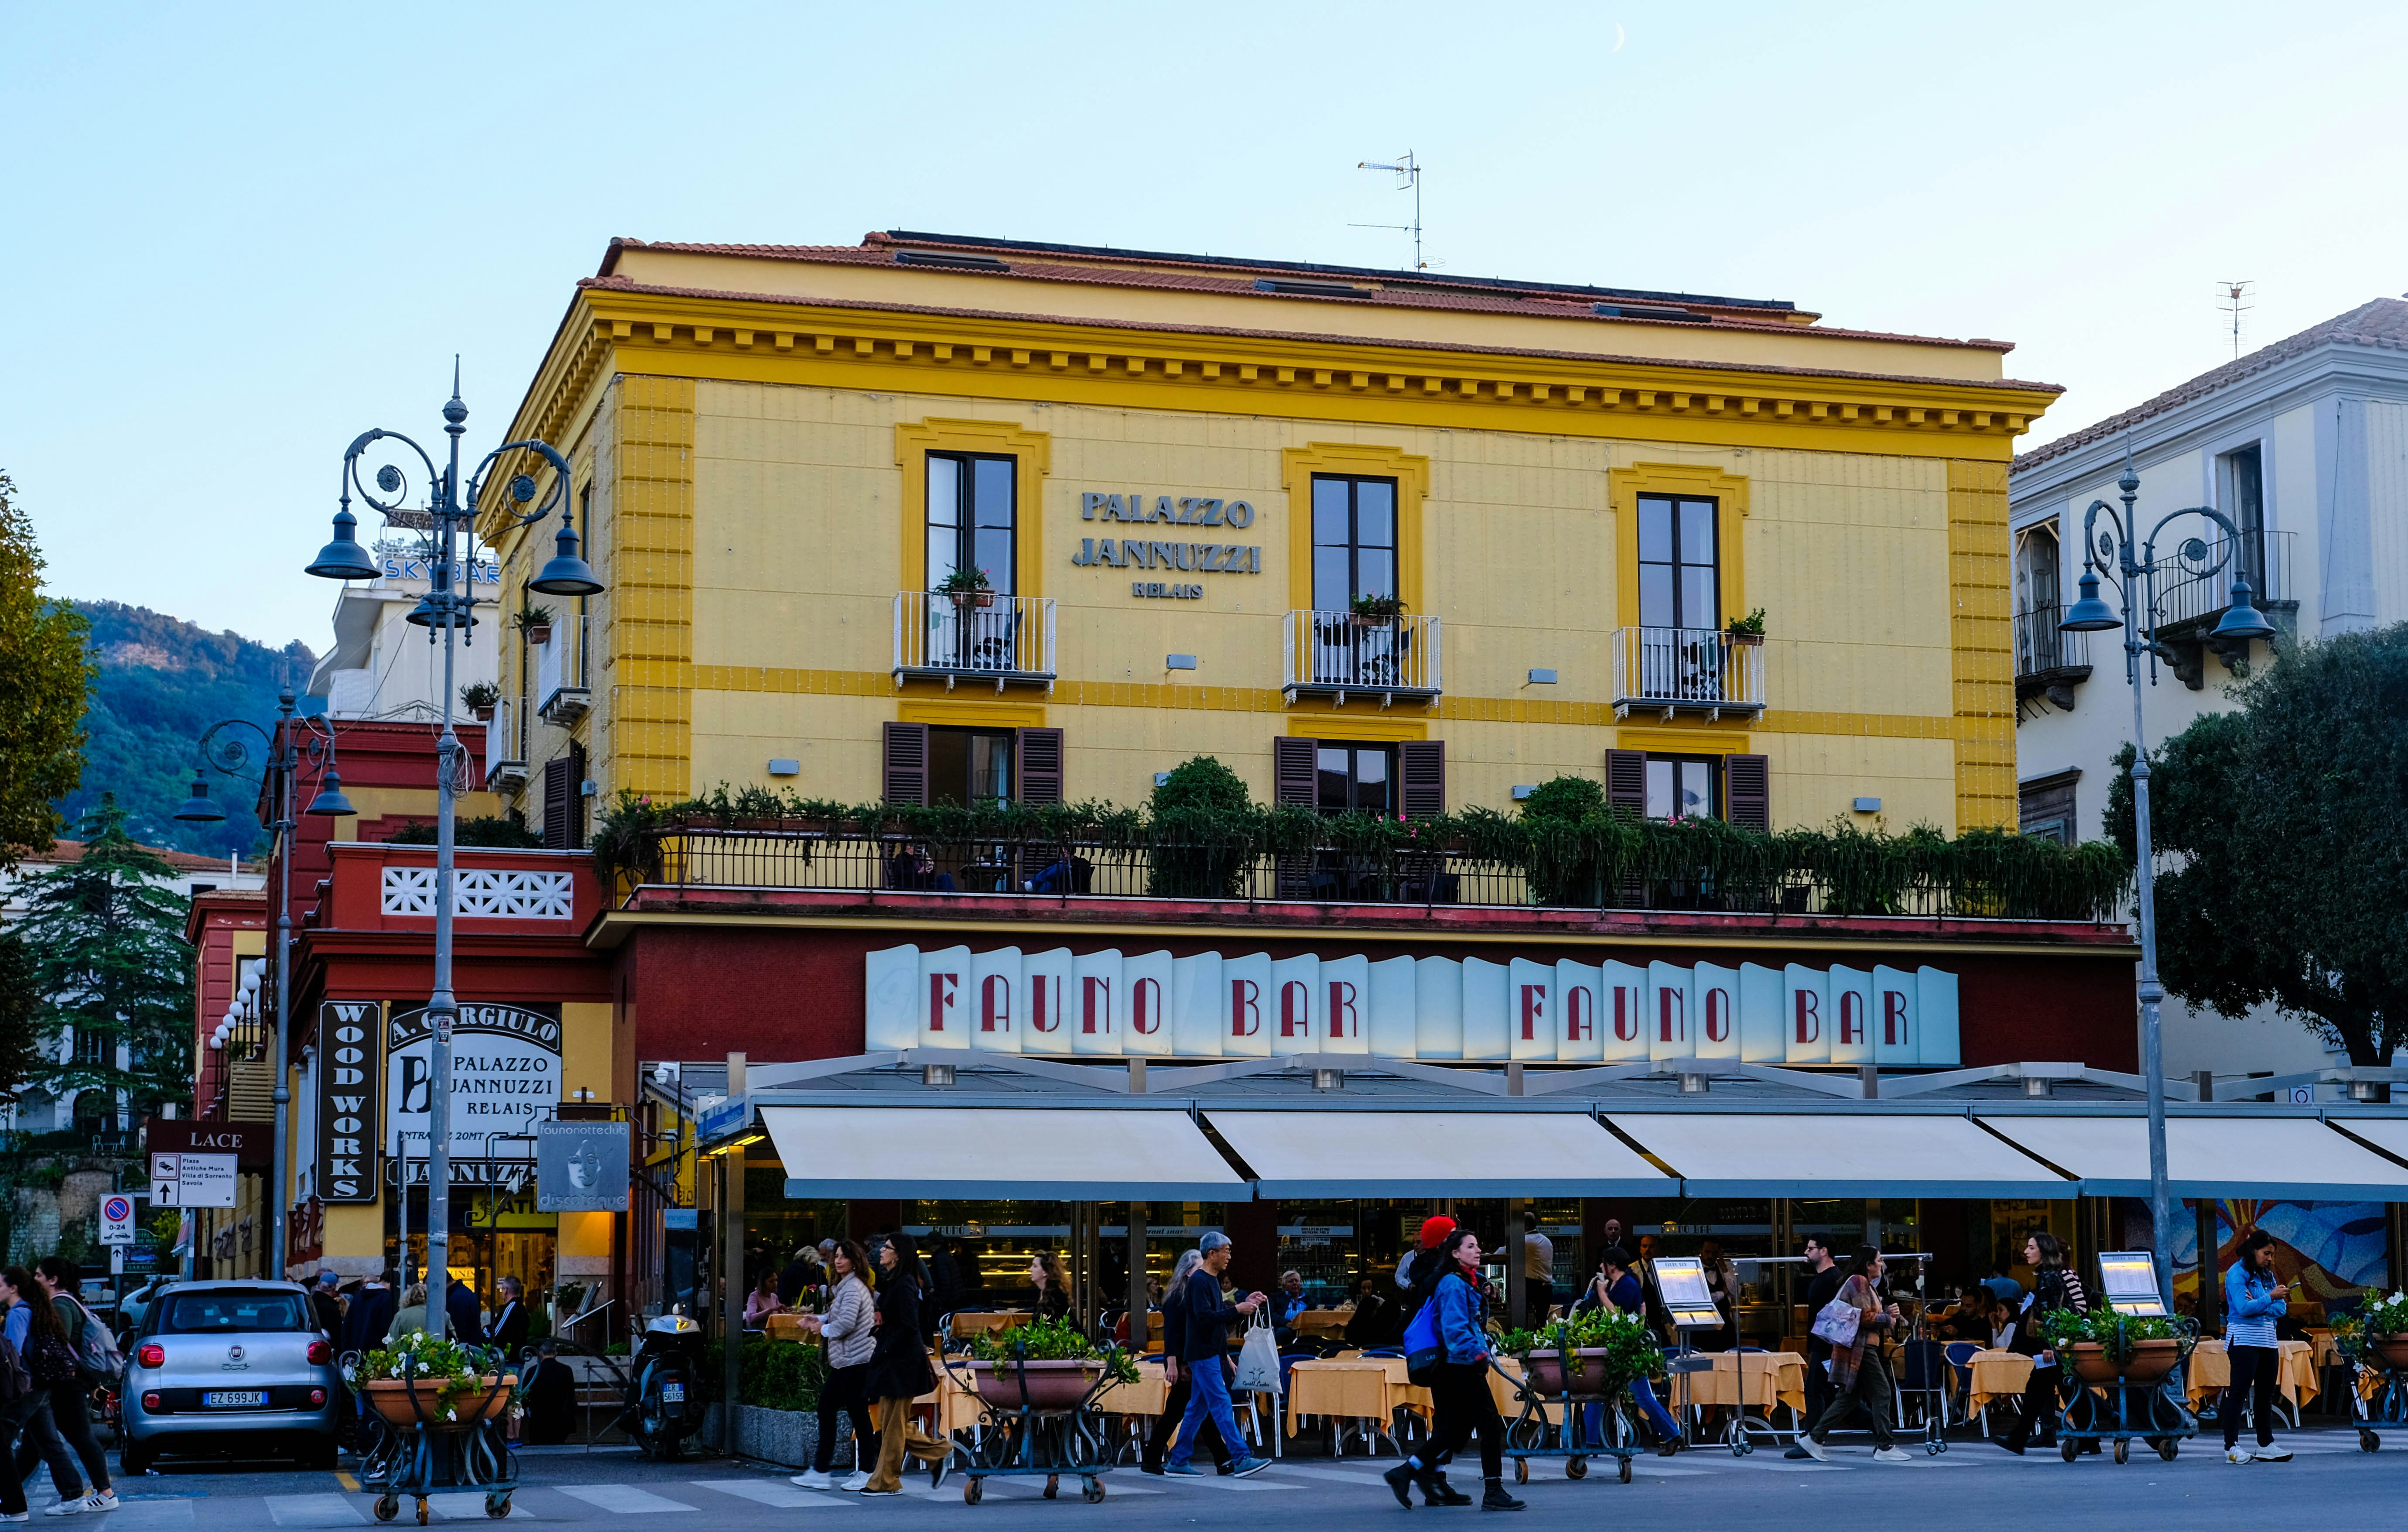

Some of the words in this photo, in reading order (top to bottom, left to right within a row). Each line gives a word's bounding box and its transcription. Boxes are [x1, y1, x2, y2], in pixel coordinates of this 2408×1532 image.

[1082, 492, 1255, 528] PALAZZO
[1071, 538, 1262, 574] JANNUZZI
[1132, 582, 1204, 598] RELAIS
[929, 973, 1161, 1035] FAUNO
[1231, 980, 1357, 1038] BAR
[1521, 985, 1729, 1043] FAUNO
[1795, 989, 1907, 1045] BAR
[393, 1022, 417, 1042] A.
[421, 1007, 557, 1041] GRGIULO
[332, 1005, 368, 1085] WOOD
[453, 1056, 548, 1072] PALAZZO
[450, 1079, 552, 1094] JANNUZZI
[467, 1102, 533, 1114] RELAIS
[190, 1132, 243, 1148] LACE
[540, 1124, 627, 1134] faunonotteclub
[330, 1096, 366, 1197] WORKS
[211, 1393, 224, 1403] EZ
[227, 1392, 260, 1403] 699JK
